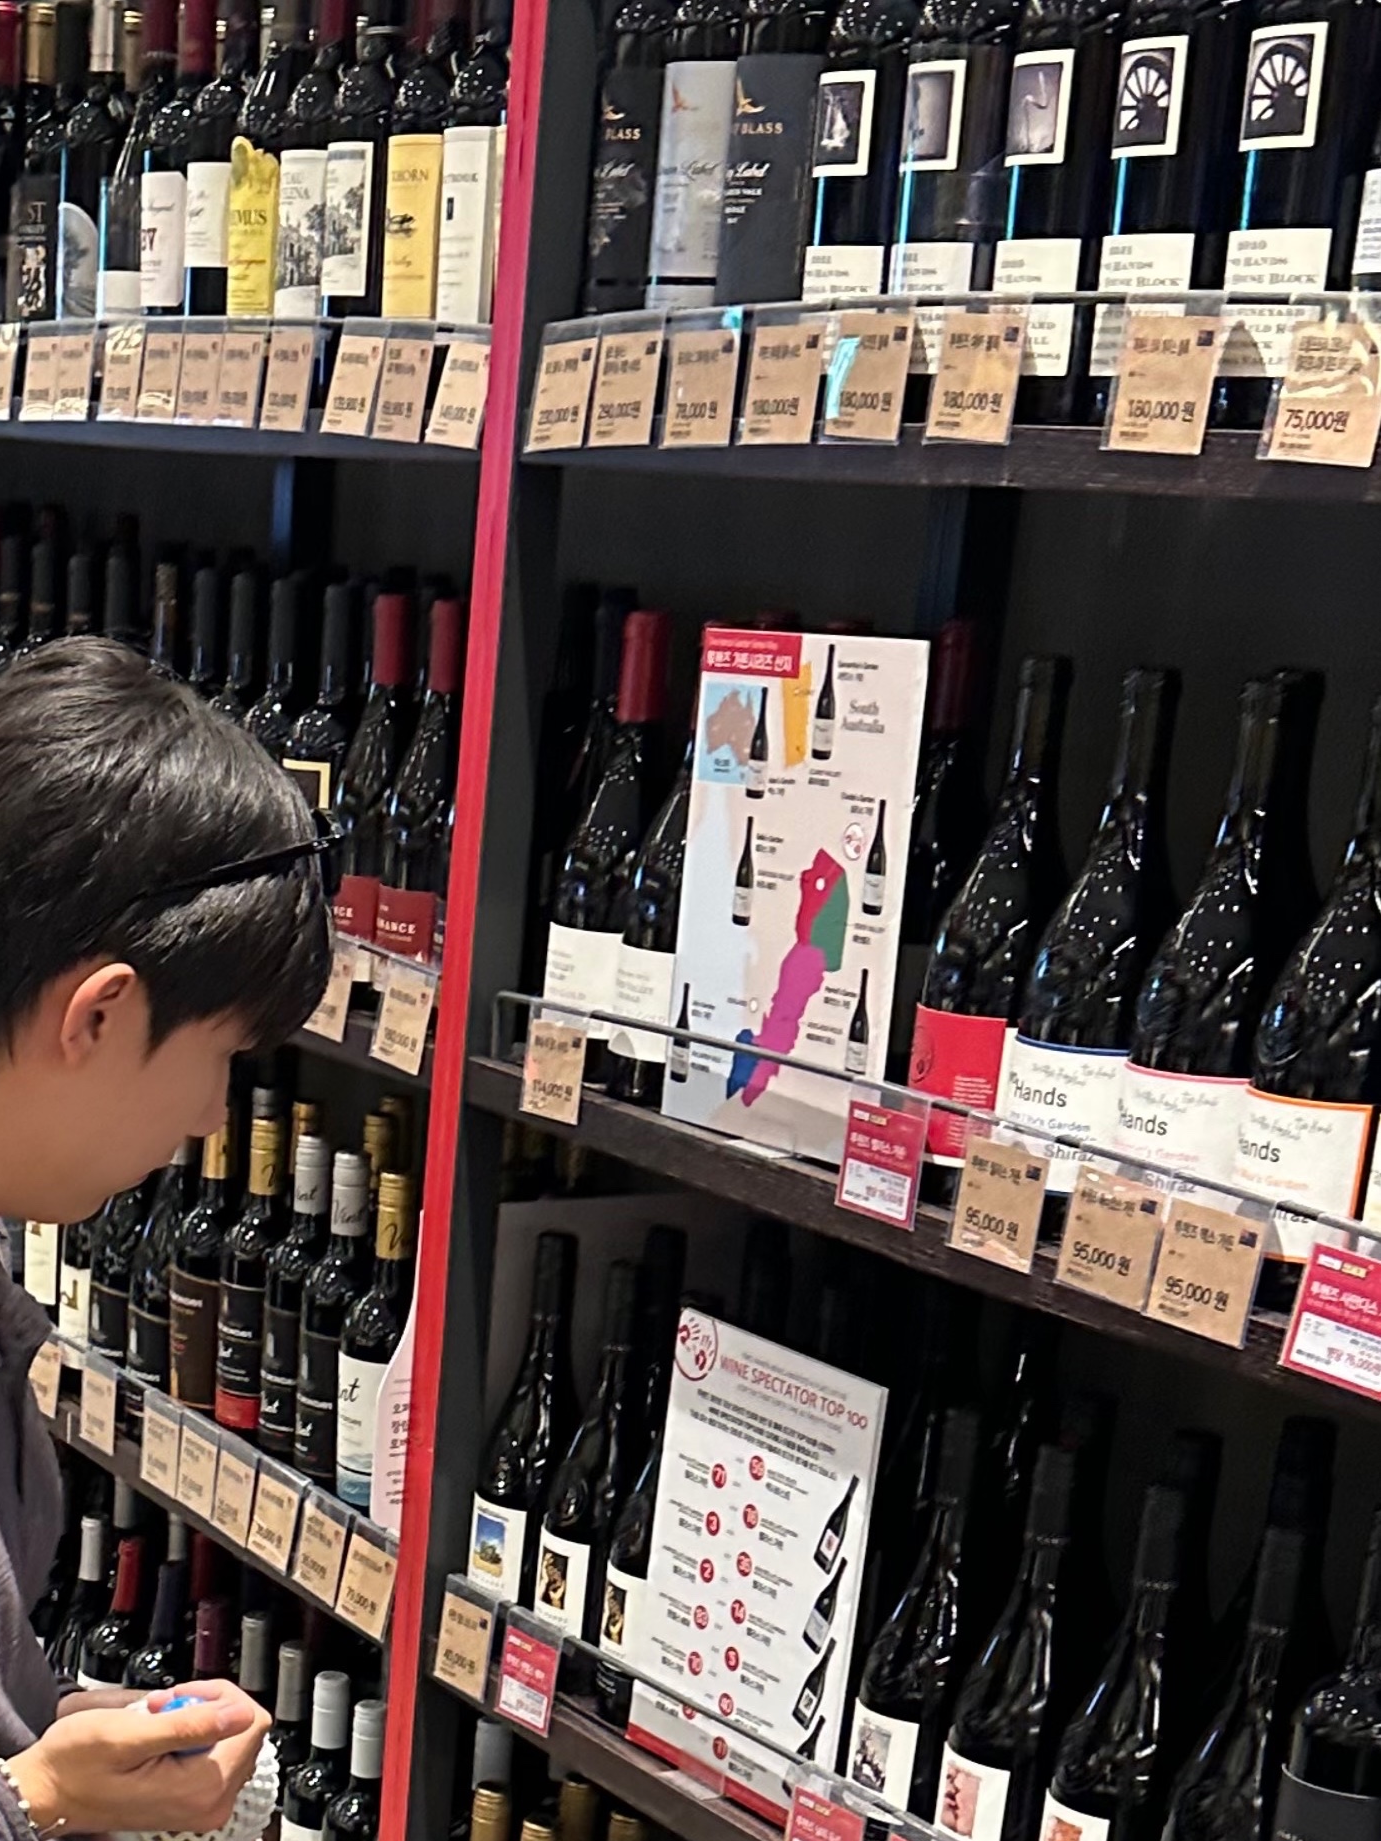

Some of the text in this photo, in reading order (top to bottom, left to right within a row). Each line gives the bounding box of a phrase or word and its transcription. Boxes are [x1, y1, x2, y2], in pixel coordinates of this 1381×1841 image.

[849, 699, 880, 715] South
[841, 714, 886, 734] Australia
[1014, 1079, 1067, 1107] Hands
[1119, 1109, 1168, 1136] Hands
[1043, 1143, 1095, 1163] Shiraz
[1144, 1172, 1197, 1194] Shiraz
[1073, 1240, 1114, 1270] 95,000
[1165, 1275, 1212, 1306] 95,000
[720, 1354, 868, 1431] WINE SPECTATOR TOP 100
